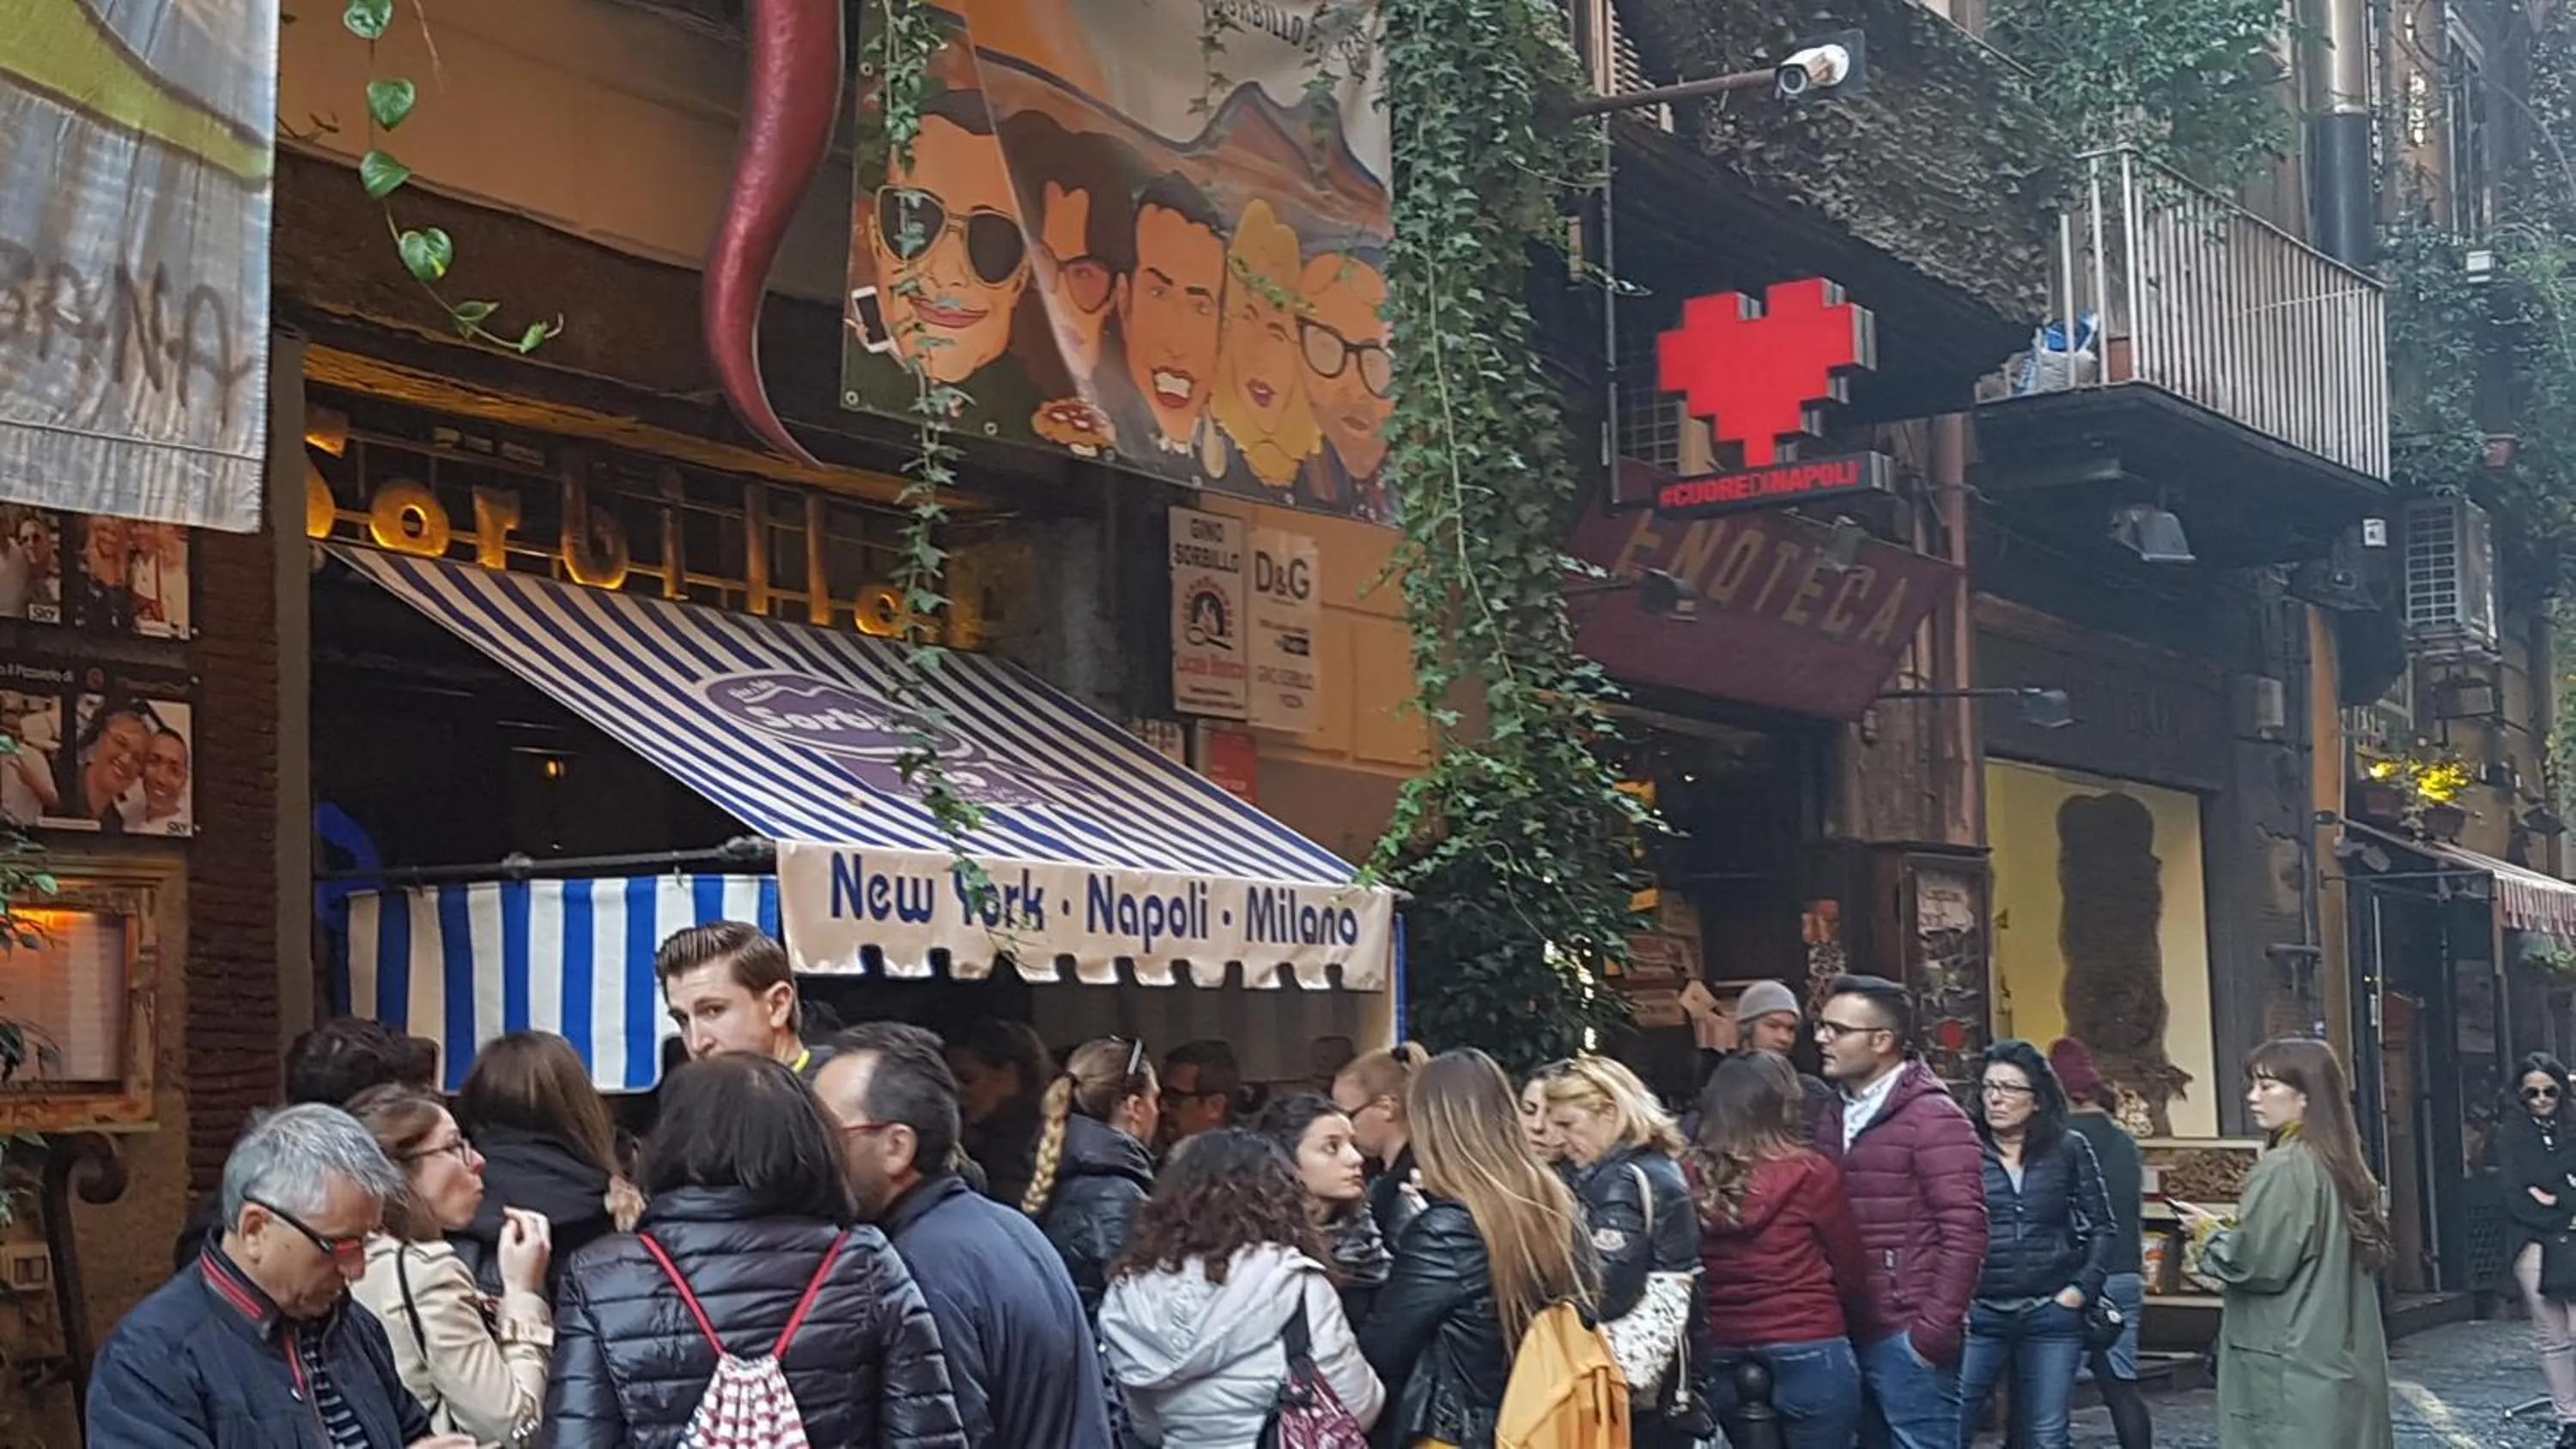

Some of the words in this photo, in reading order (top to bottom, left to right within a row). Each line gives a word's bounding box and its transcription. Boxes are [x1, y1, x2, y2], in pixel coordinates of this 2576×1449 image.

[1255, 549, 1310, 601] D&G
[831, 850, 934, 924] New
[952, 865, 1044, 931] York
[1085, 872, 1207, 955] Napoli
[1246, 885, 1358, 946] Milano
